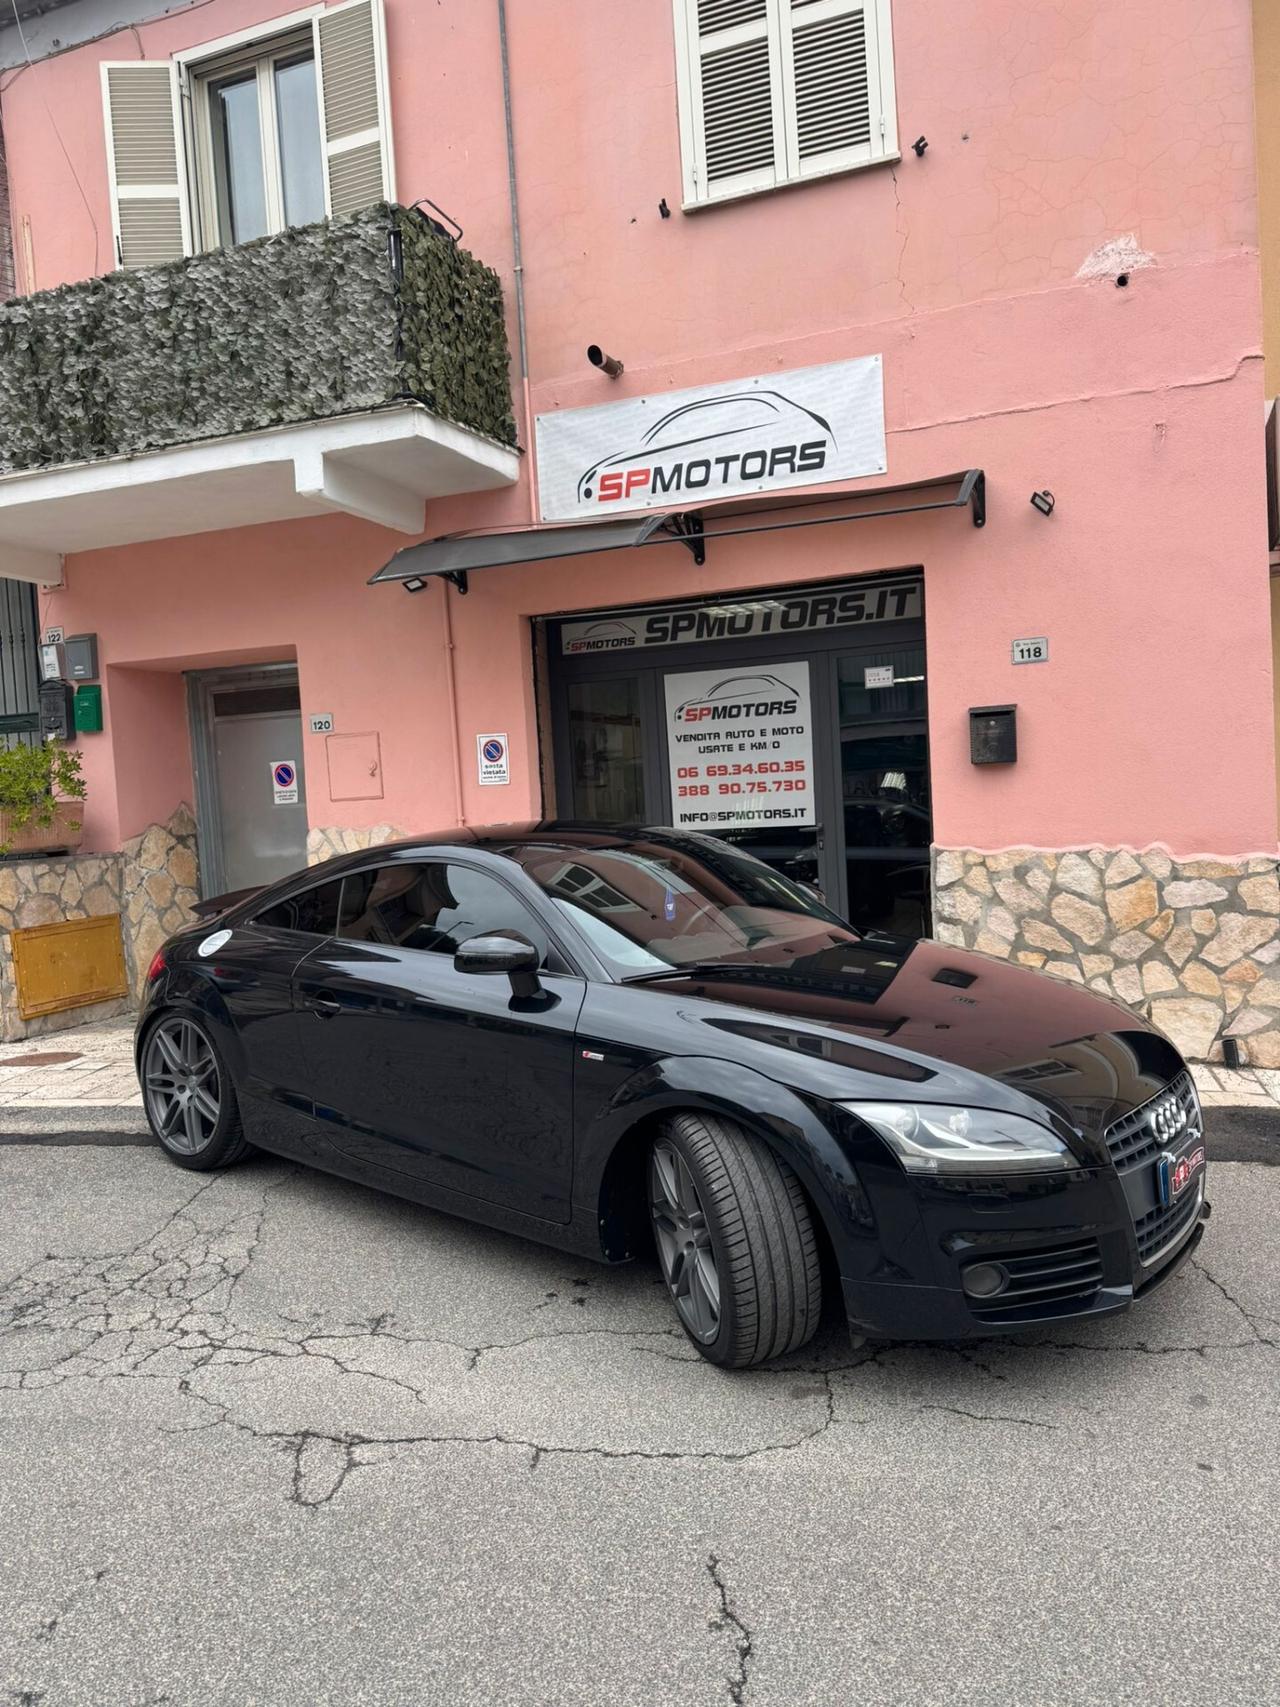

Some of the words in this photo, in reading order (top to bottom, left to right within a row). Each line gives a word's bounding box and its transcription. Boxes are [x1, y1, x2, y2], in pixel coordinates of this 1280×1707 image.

[598, 440, 826, 502] SPMOTORS
[644, 586, 917, 644] SPMOTORS.IT
[570, 636, 636, 652] SPMOTORS
[1019, 646, 1042, 660] 118
[684, 700, 797, 721] SPMOTORS
[313, 720, 331, 730] 120
[676, 732, 720, 742] VENDITA
[725, 729, 755, 739] AUTO
[760, 728, 767, 737] E
[772, 726, 804, 735] MOTO
[698, 744, 733, 753] USATE
[738, 743, 746, 751] E
[750, 741, 767, 751] KM
[677, 767, 698, 778] 06
[706, 760, 805, 777] 69.34.60.35
[678, 785, 710, 796] 388
[718, 779, 806, 795] 90.75.730
[680, 808, 807, 822] INFO@SPMOTORS.IT
